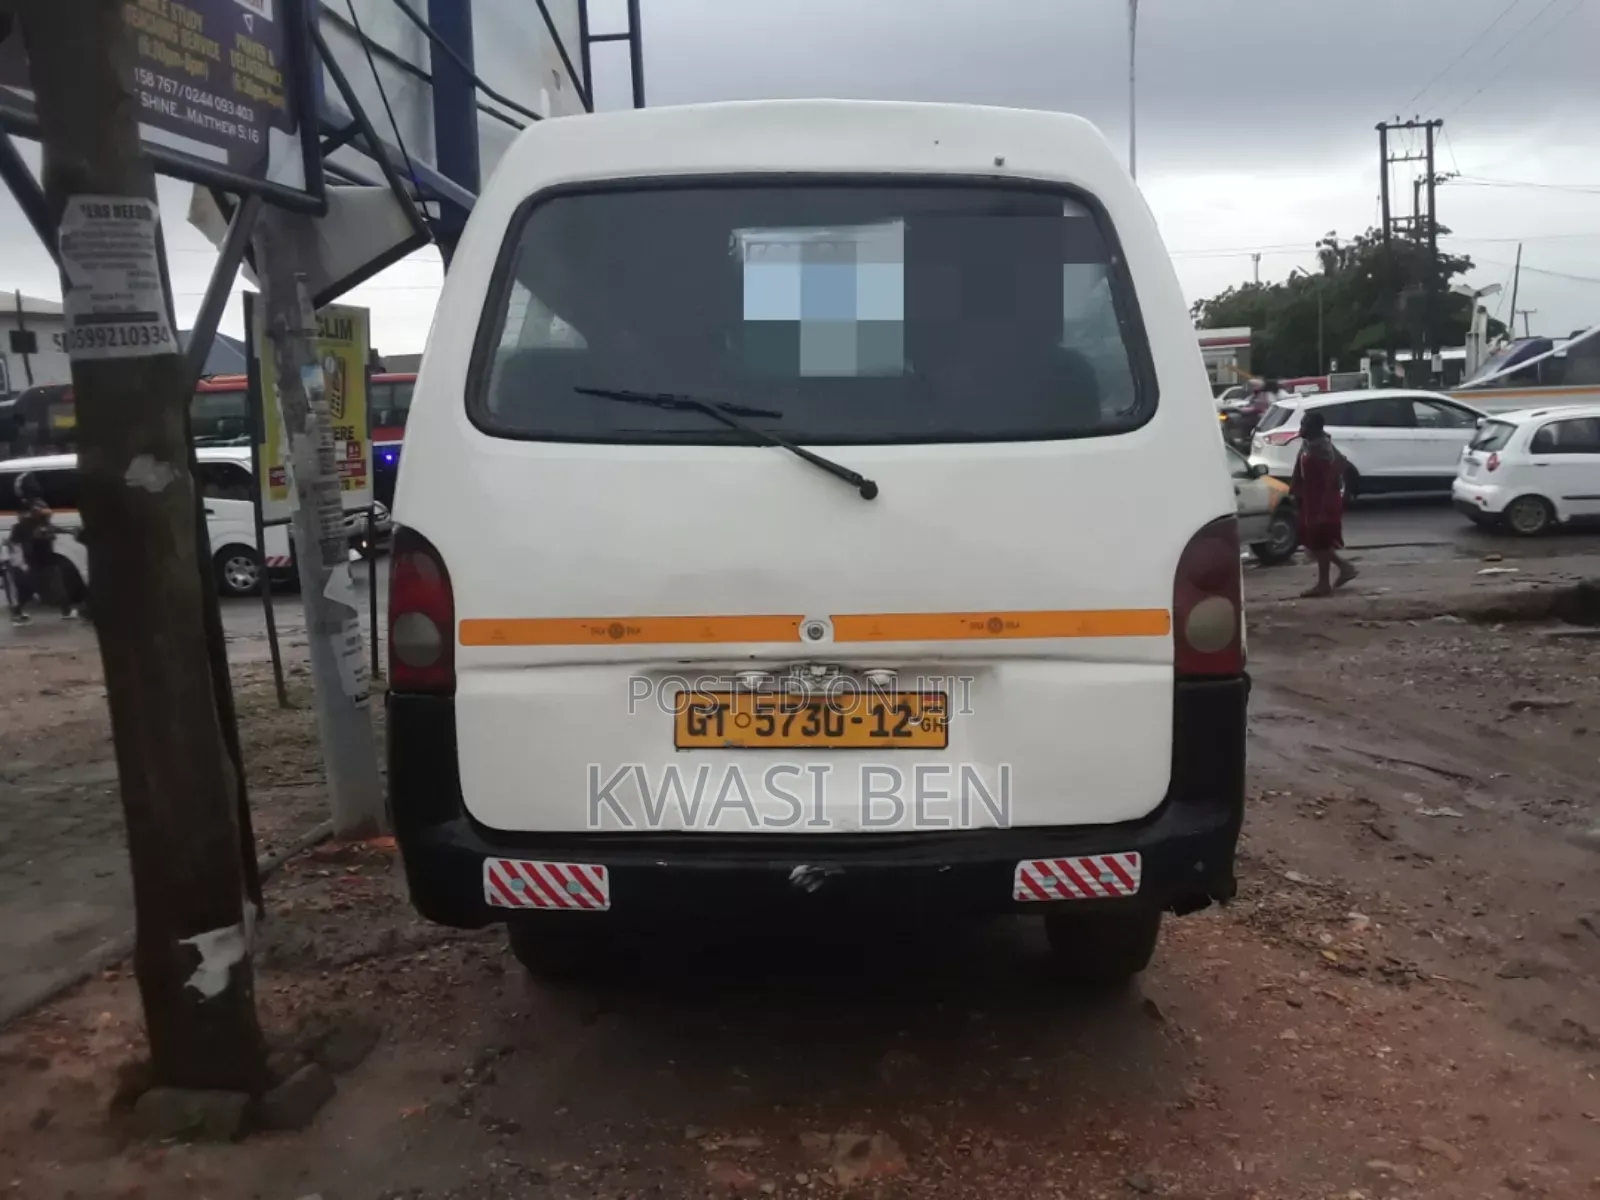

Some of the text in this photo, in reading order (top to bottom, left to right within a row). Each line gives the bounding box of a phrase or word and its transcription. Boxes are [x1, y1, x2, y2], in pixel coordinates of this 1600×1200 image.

[180, 28, 221, 62] SERVICE
[687, 703, 730, 737] GT
[920, 716, 945, 734] GH
